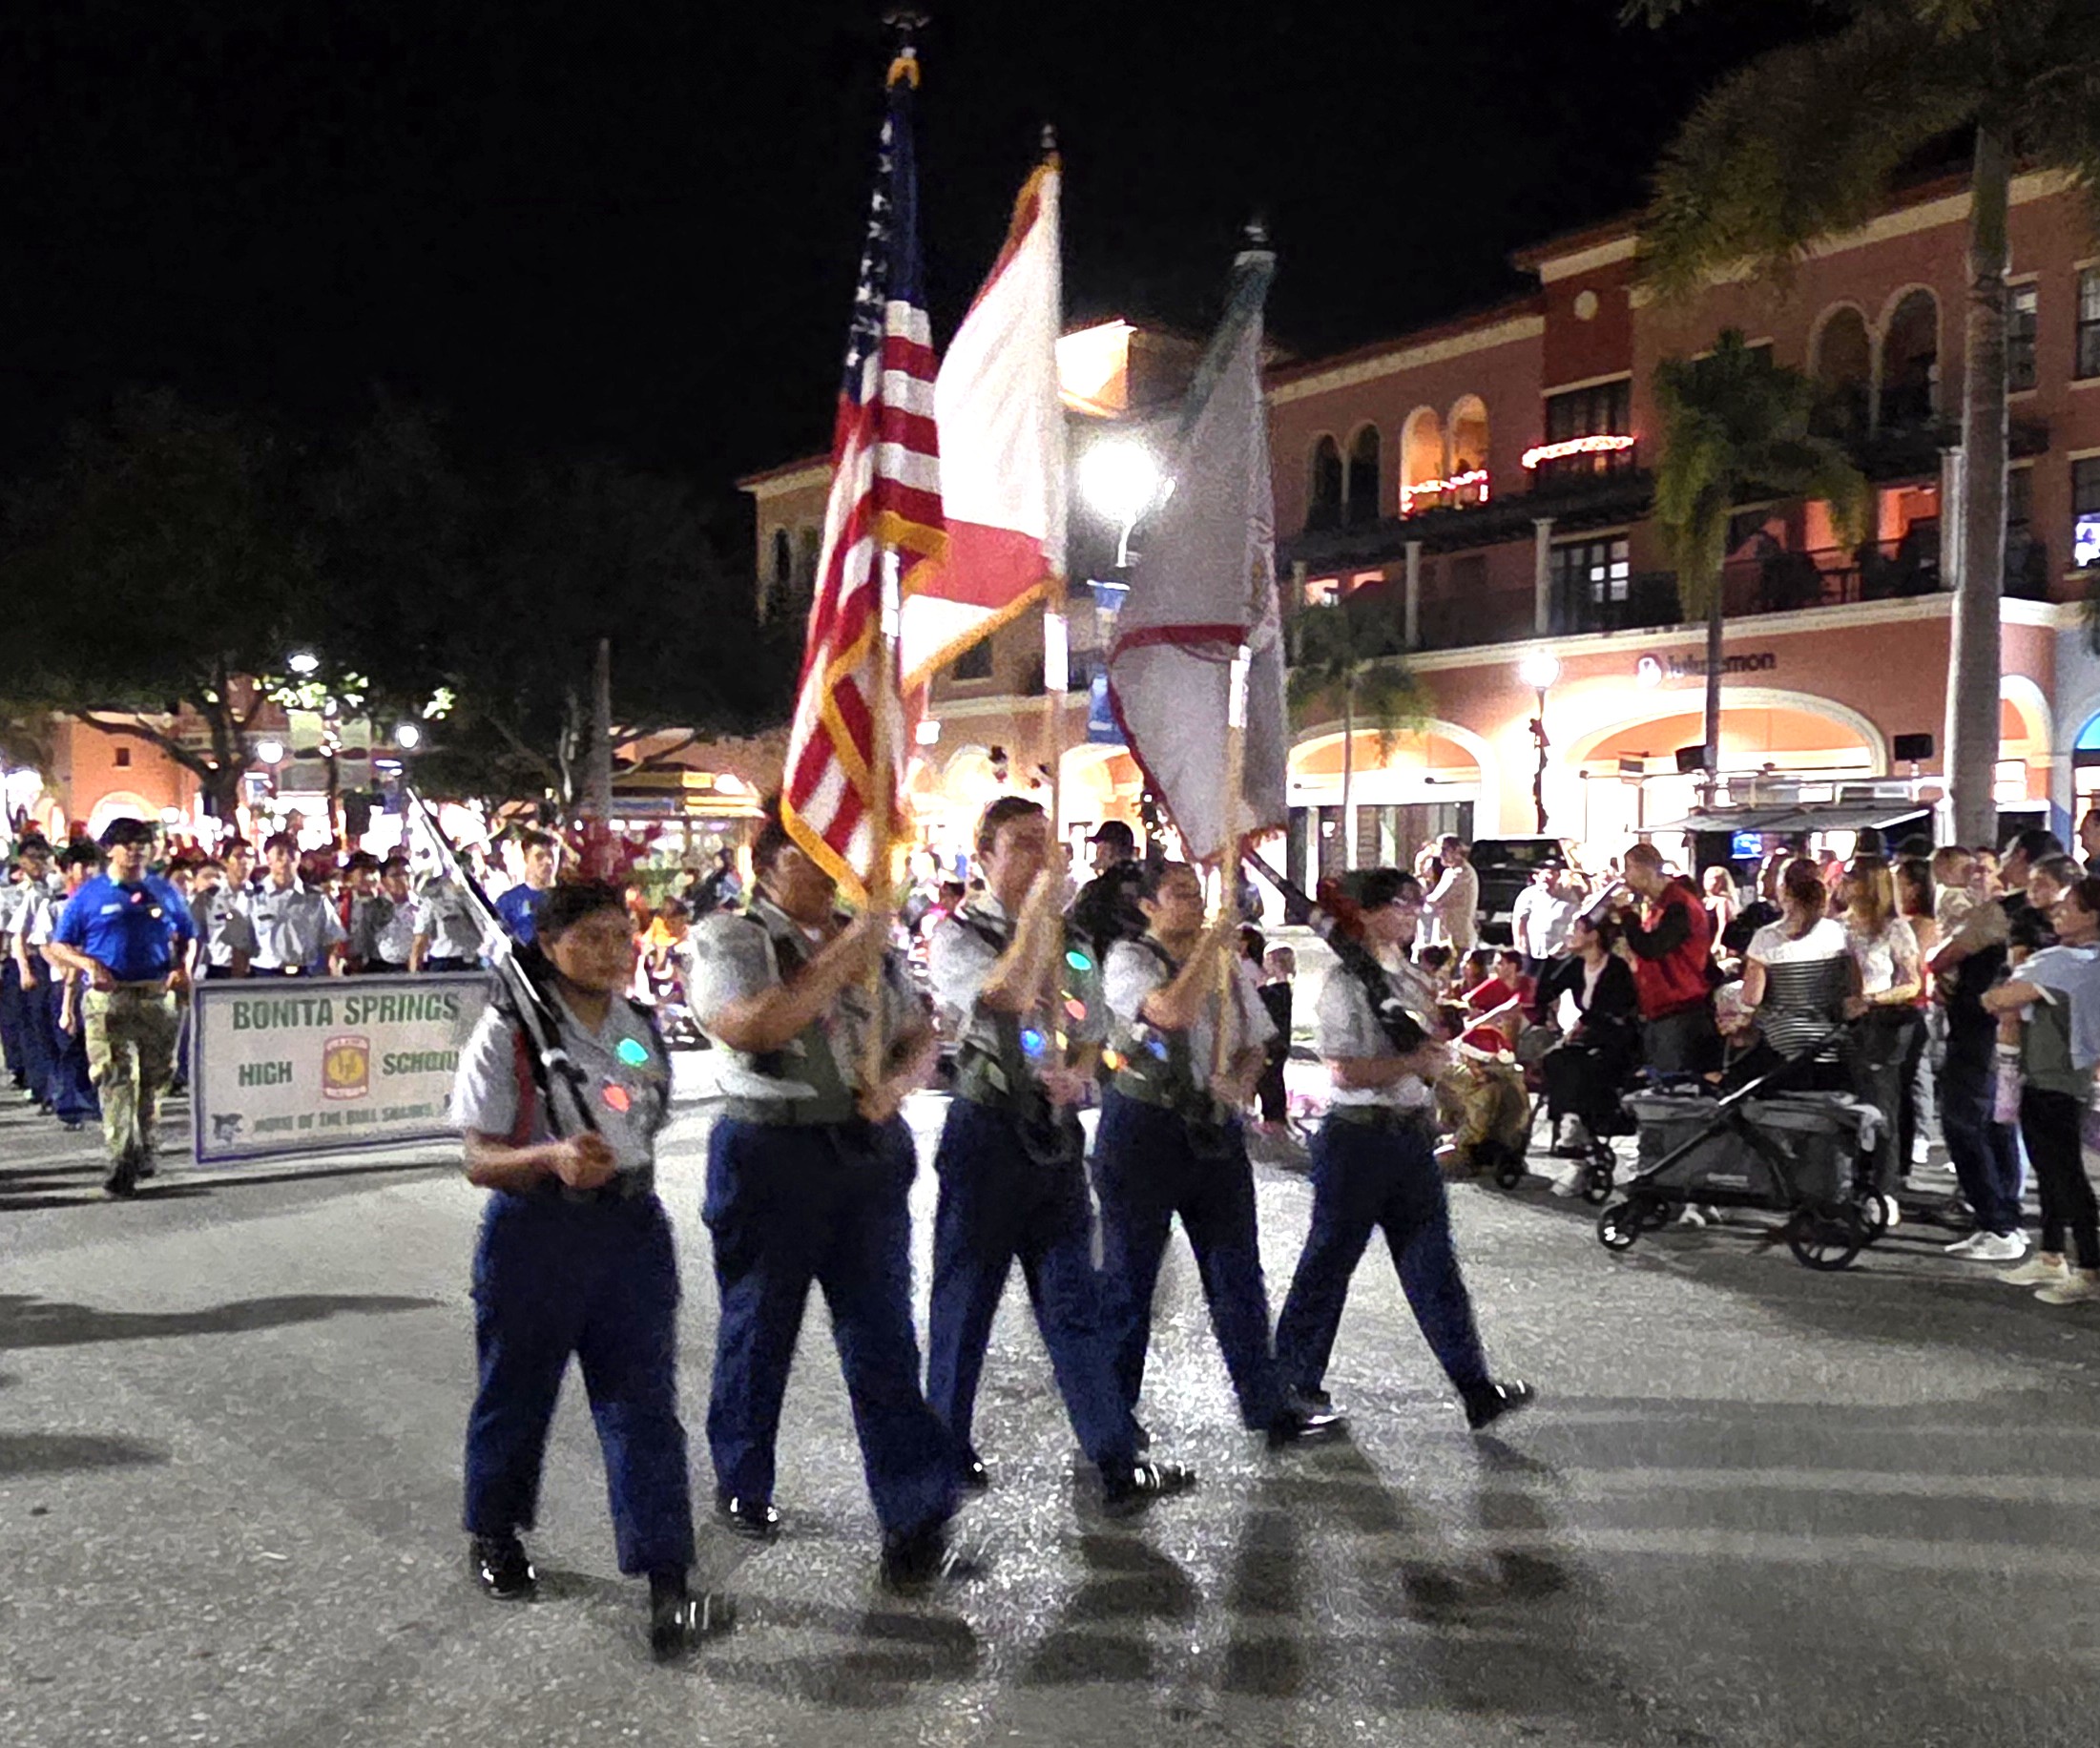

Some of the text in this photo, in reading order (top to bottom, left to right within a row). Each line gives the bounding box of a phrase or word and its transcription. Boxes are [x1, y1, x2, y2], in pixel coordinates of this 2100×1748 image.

[233, 991, 461, 1030] BONITA SPRINGS
[239, 1061, 293, 1087] HIGH
